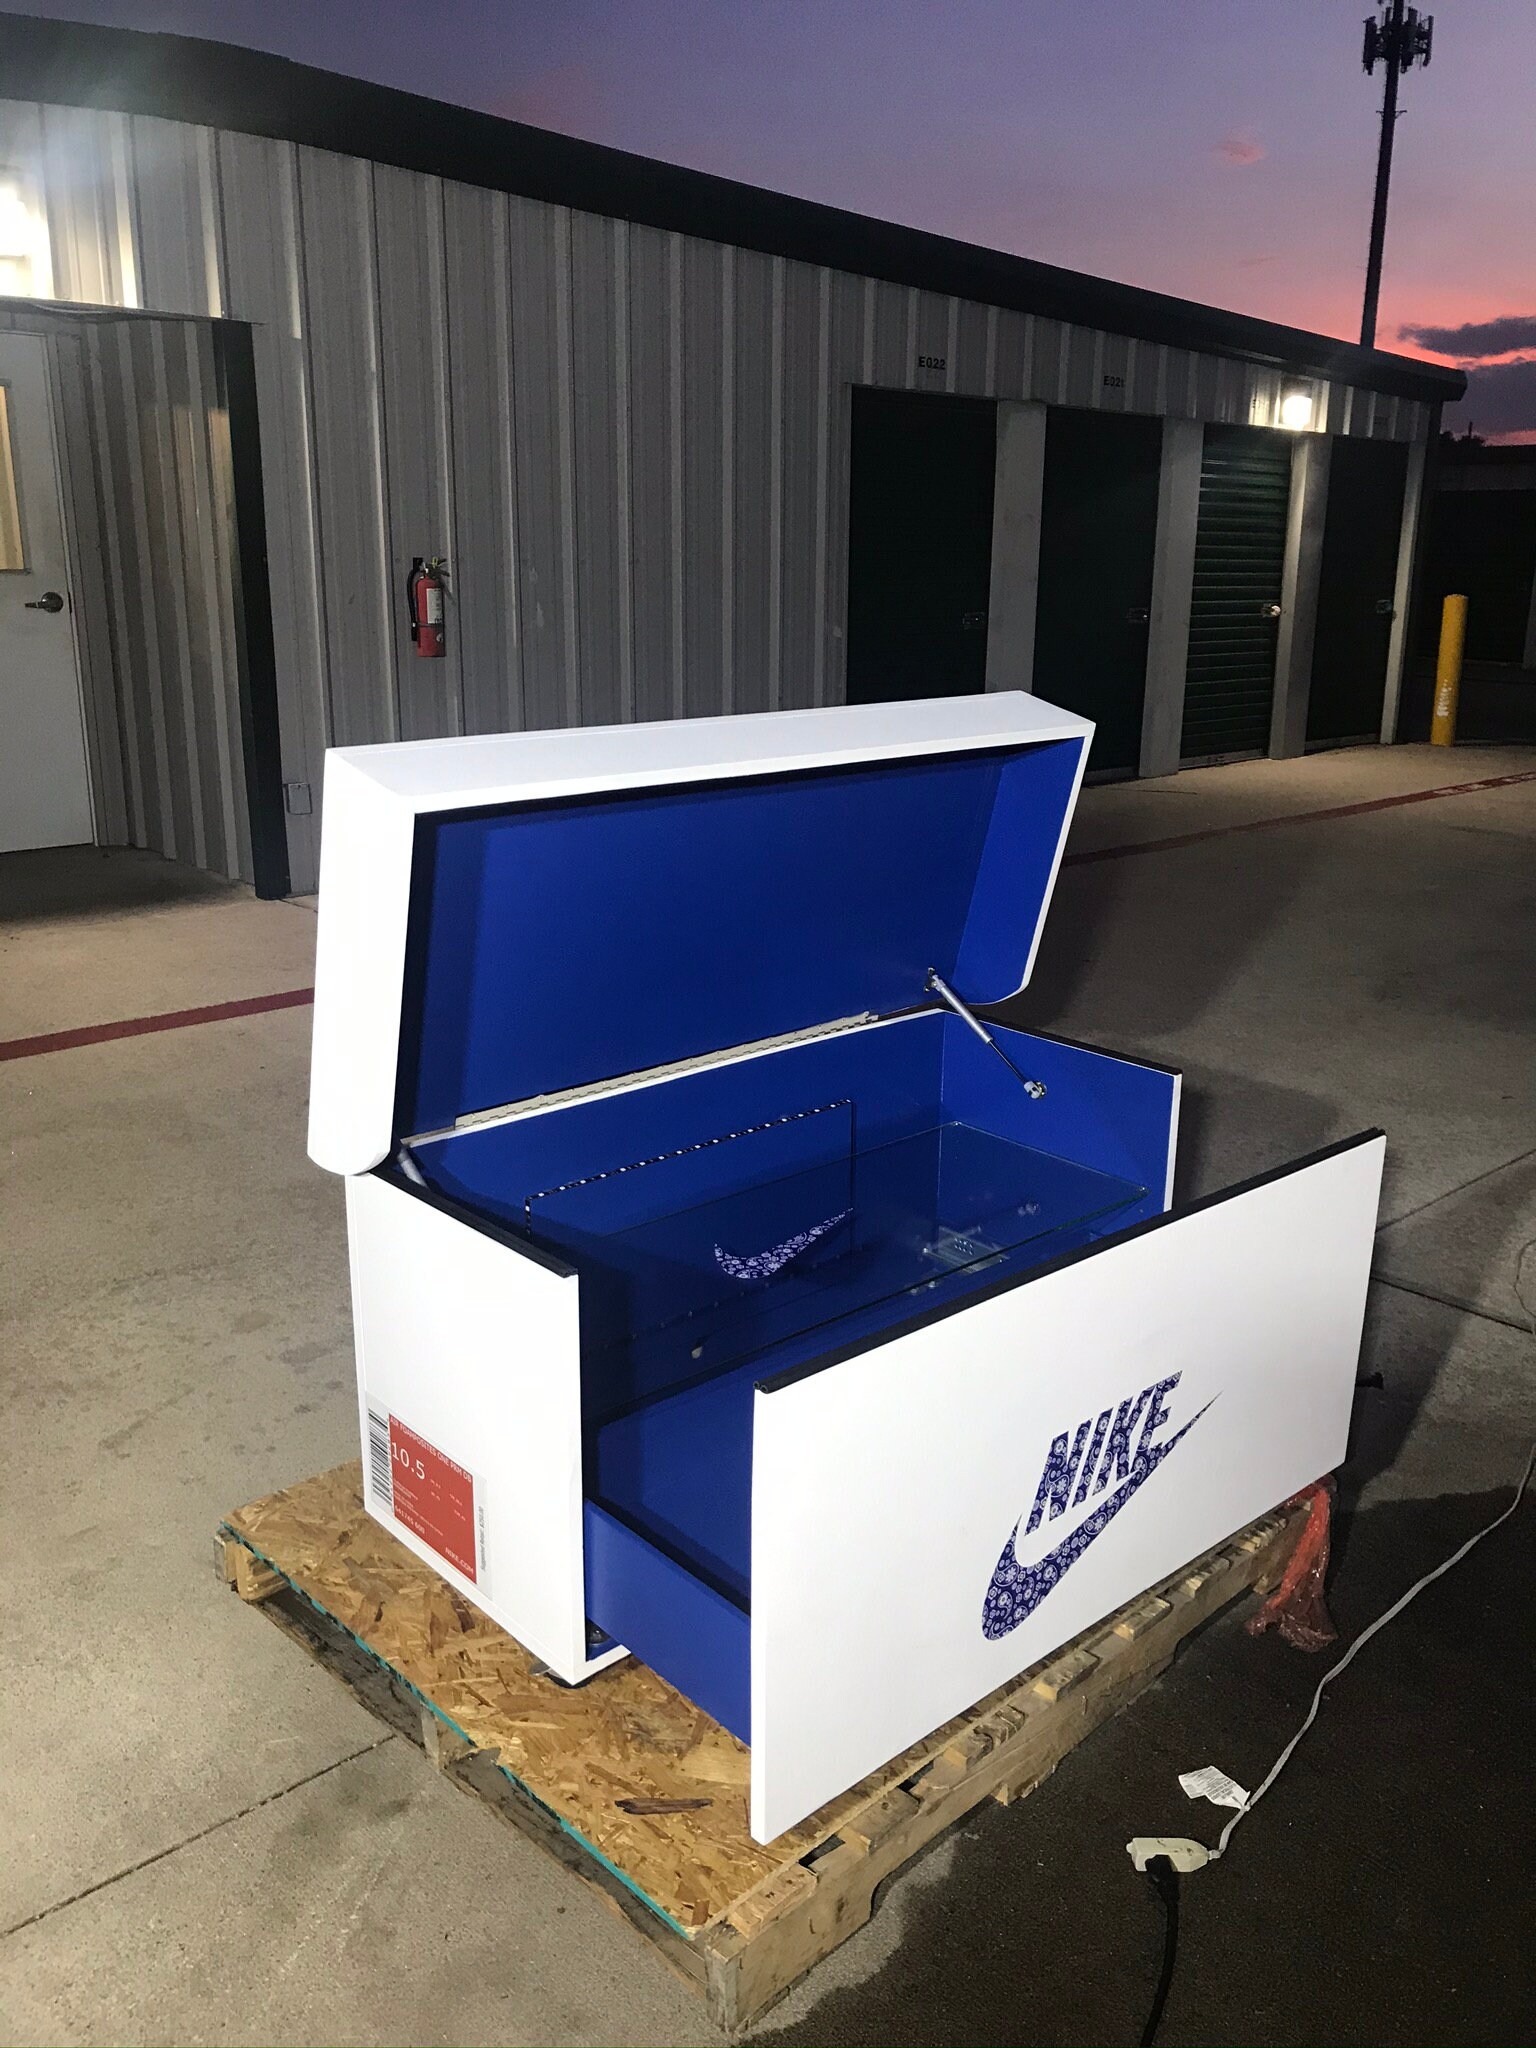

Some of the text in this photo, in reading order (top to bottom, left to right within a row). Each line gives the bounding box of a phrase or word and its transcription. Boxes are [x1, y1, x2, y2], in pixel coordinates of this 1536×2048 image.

[918, 356, 946, 370] E022
[1103, 375, 1124, 388] E021
[392, 1441, 425, 1480] 10.5
[1025, 1370, 1183, 1536] NIKE
